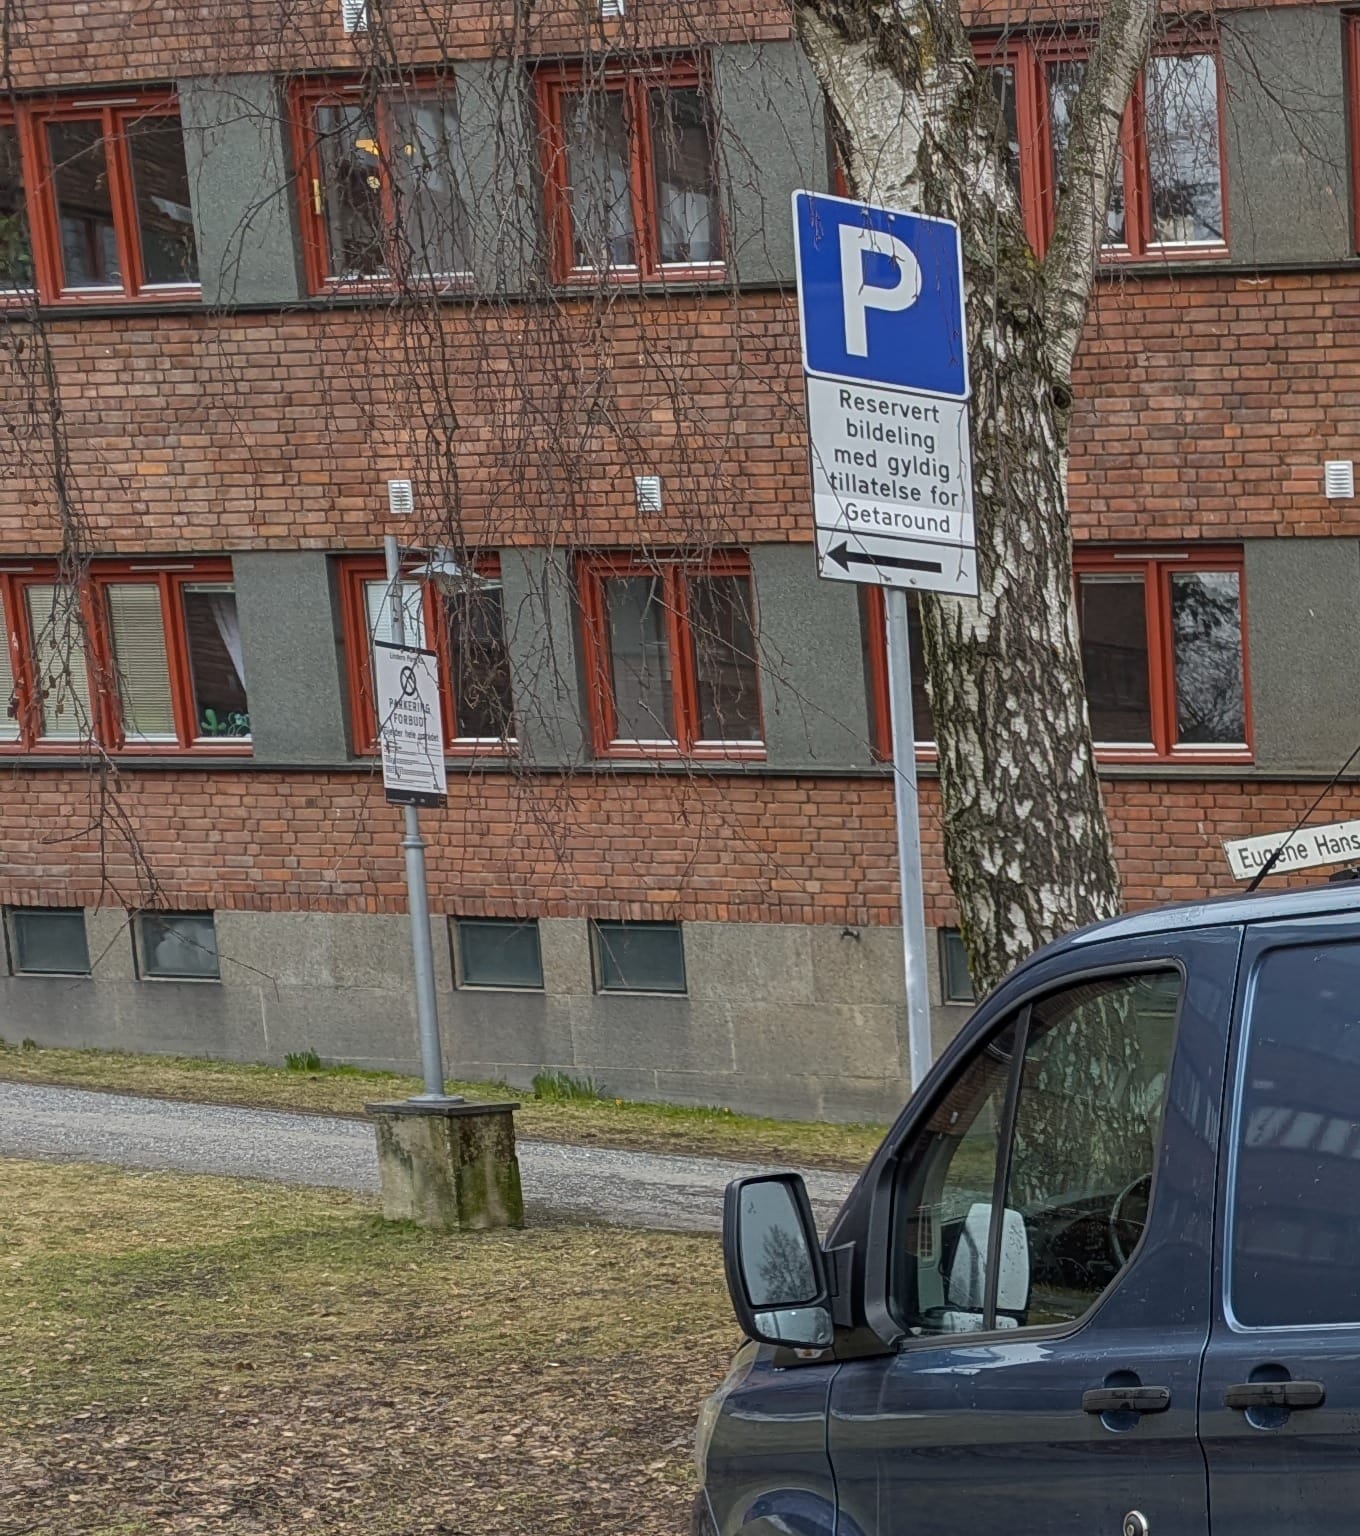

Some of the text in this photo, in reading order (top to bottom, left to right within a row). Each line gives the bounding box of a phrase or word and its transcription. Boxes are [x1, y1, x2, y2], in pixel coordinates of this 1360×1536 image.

[838, 223, 922, 358] P
[838, 388, 941, 424] Reservert
[846, 417, 936, 454] bildeling
[833, 445, 951, 483] med gyldig
[830, 471, 959, 507] tillatelse for
[844, 502, 951, 534] Getaround
